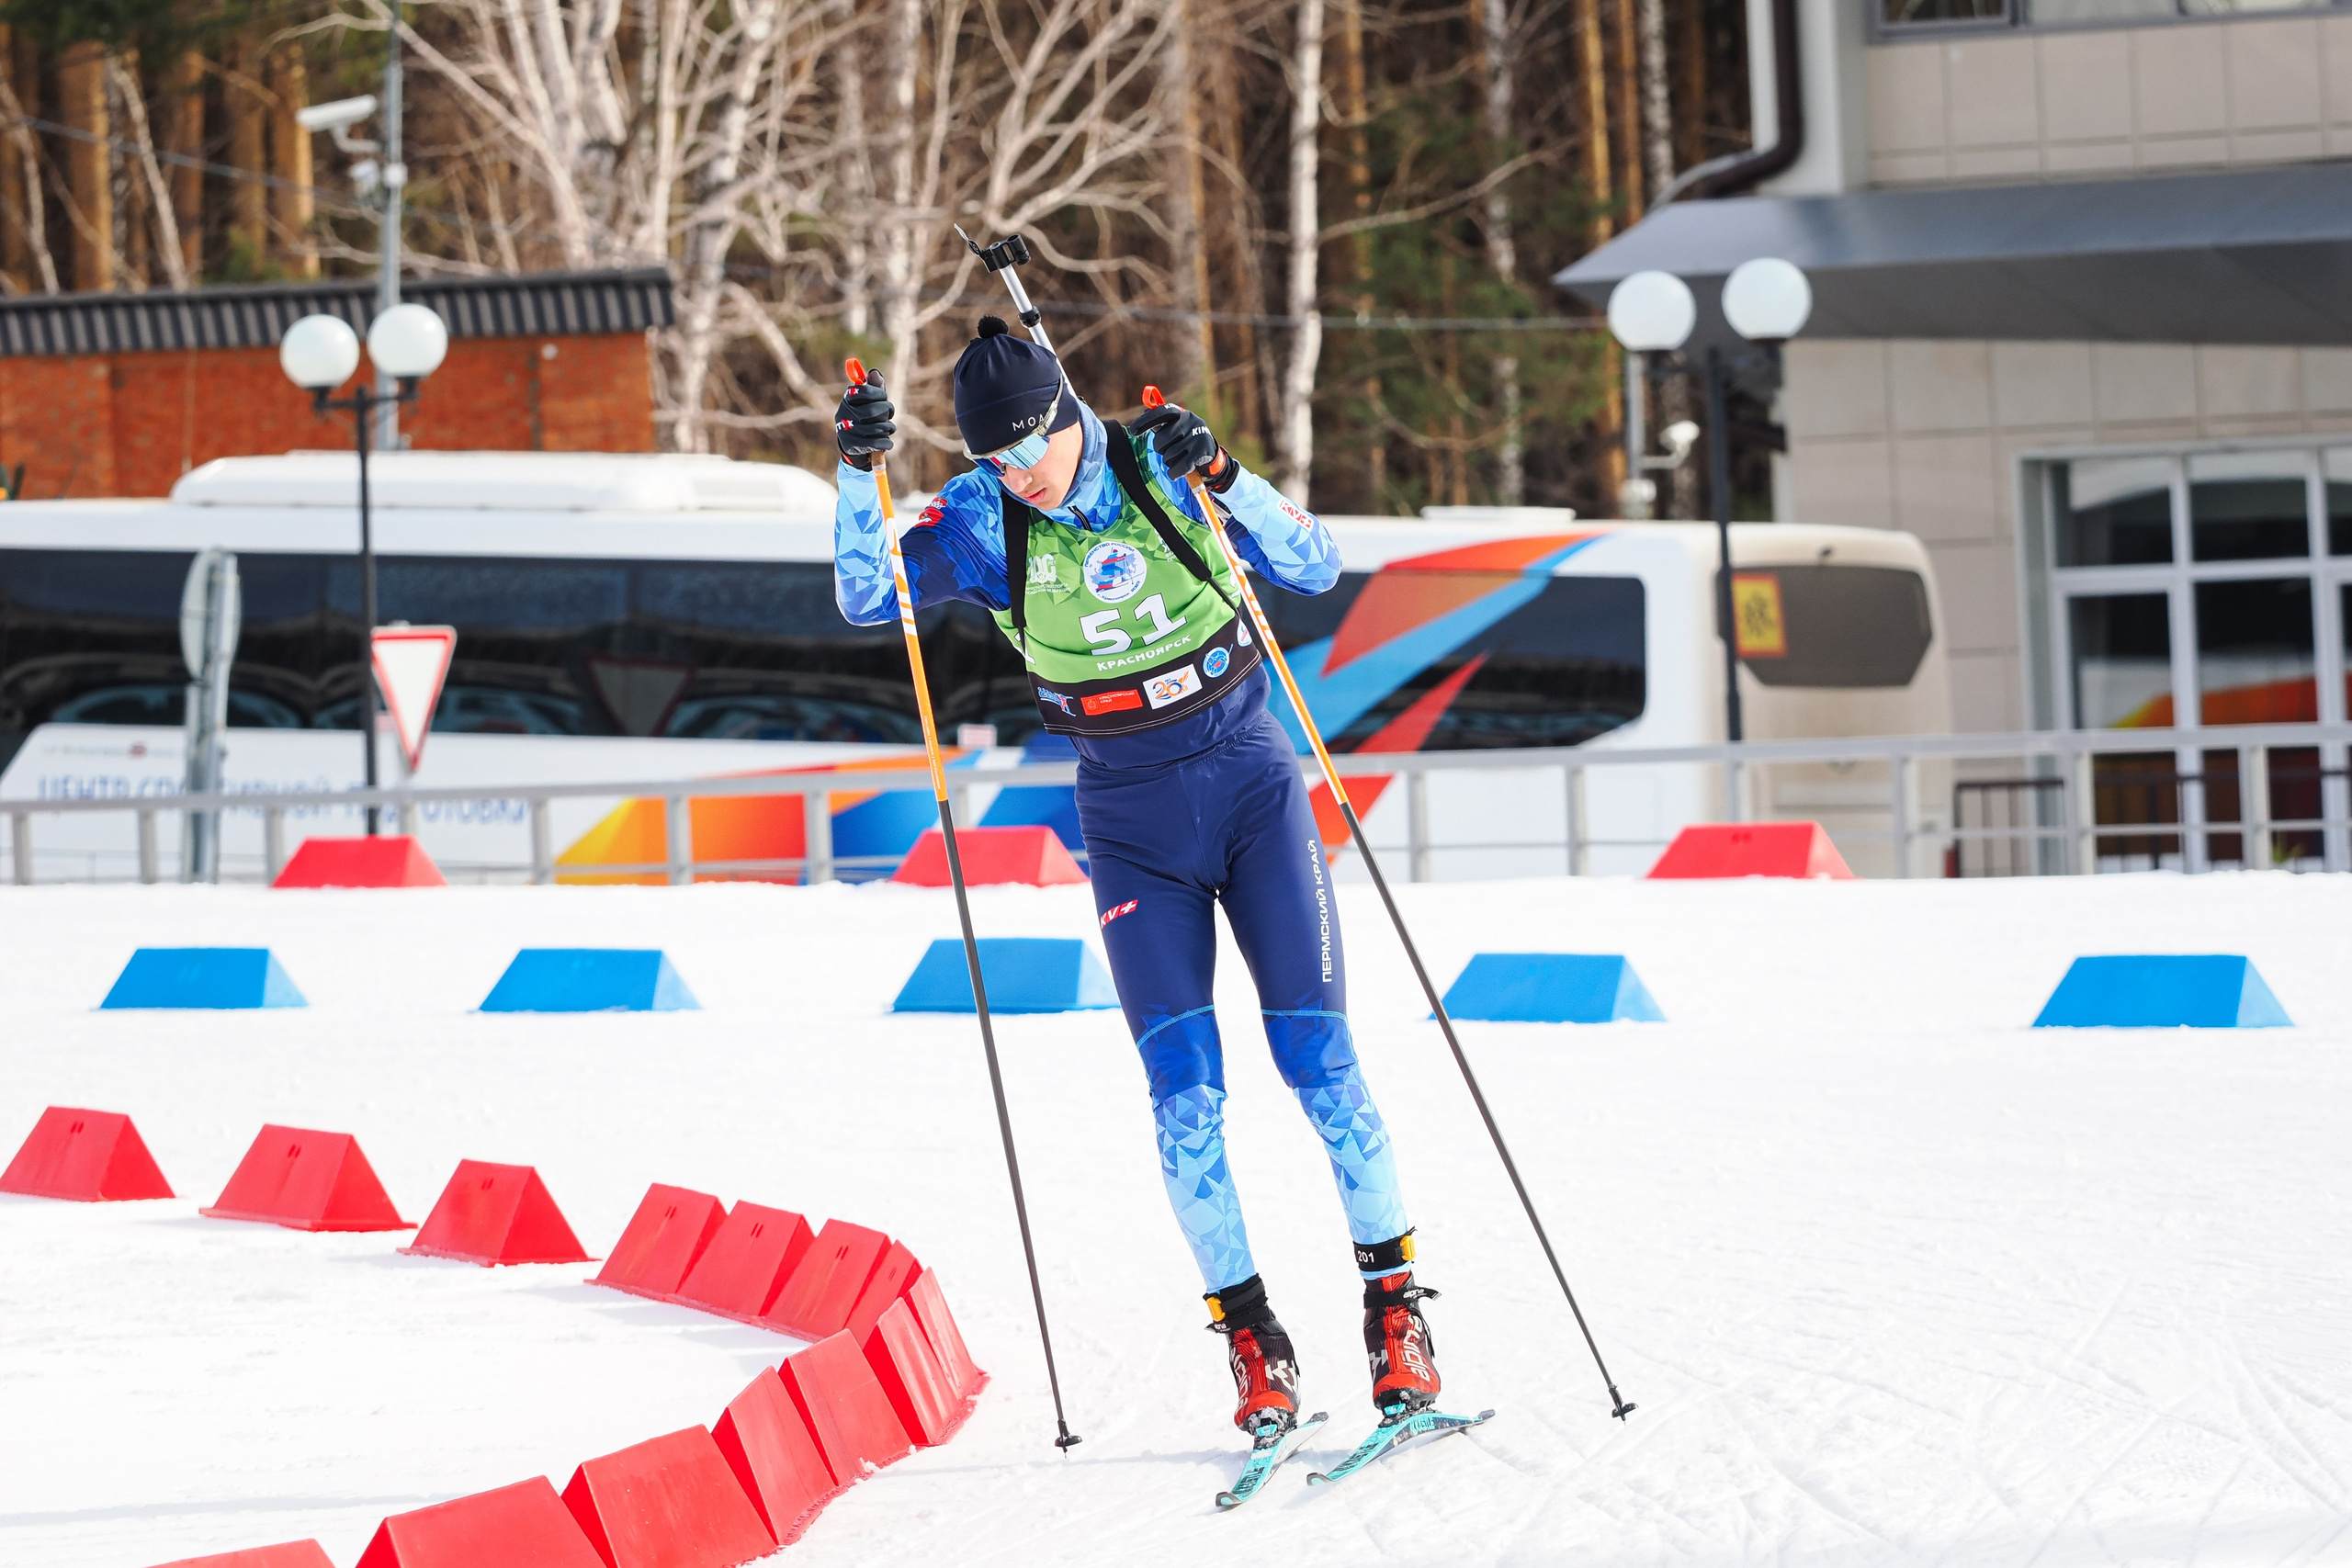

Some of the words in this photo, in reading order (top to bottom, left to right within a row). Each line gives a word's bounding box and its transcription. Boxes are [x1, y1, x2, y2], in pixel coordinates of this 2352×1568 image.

[1084, 542, 1110, 568] ПЕРВЕНСТВО
[1111, 542, 1136, 552] РОССИИ
[1079, 592, 1187, 656] 51
[1096, 635, 1192, 671] КРАСНОЯРСК
[1307, 840, 1324, 885] КРАЙ
[1315, 888, 1332, 983] ПЕРМСКИЙ
[1357, 1250, 1374, 1263] 201
